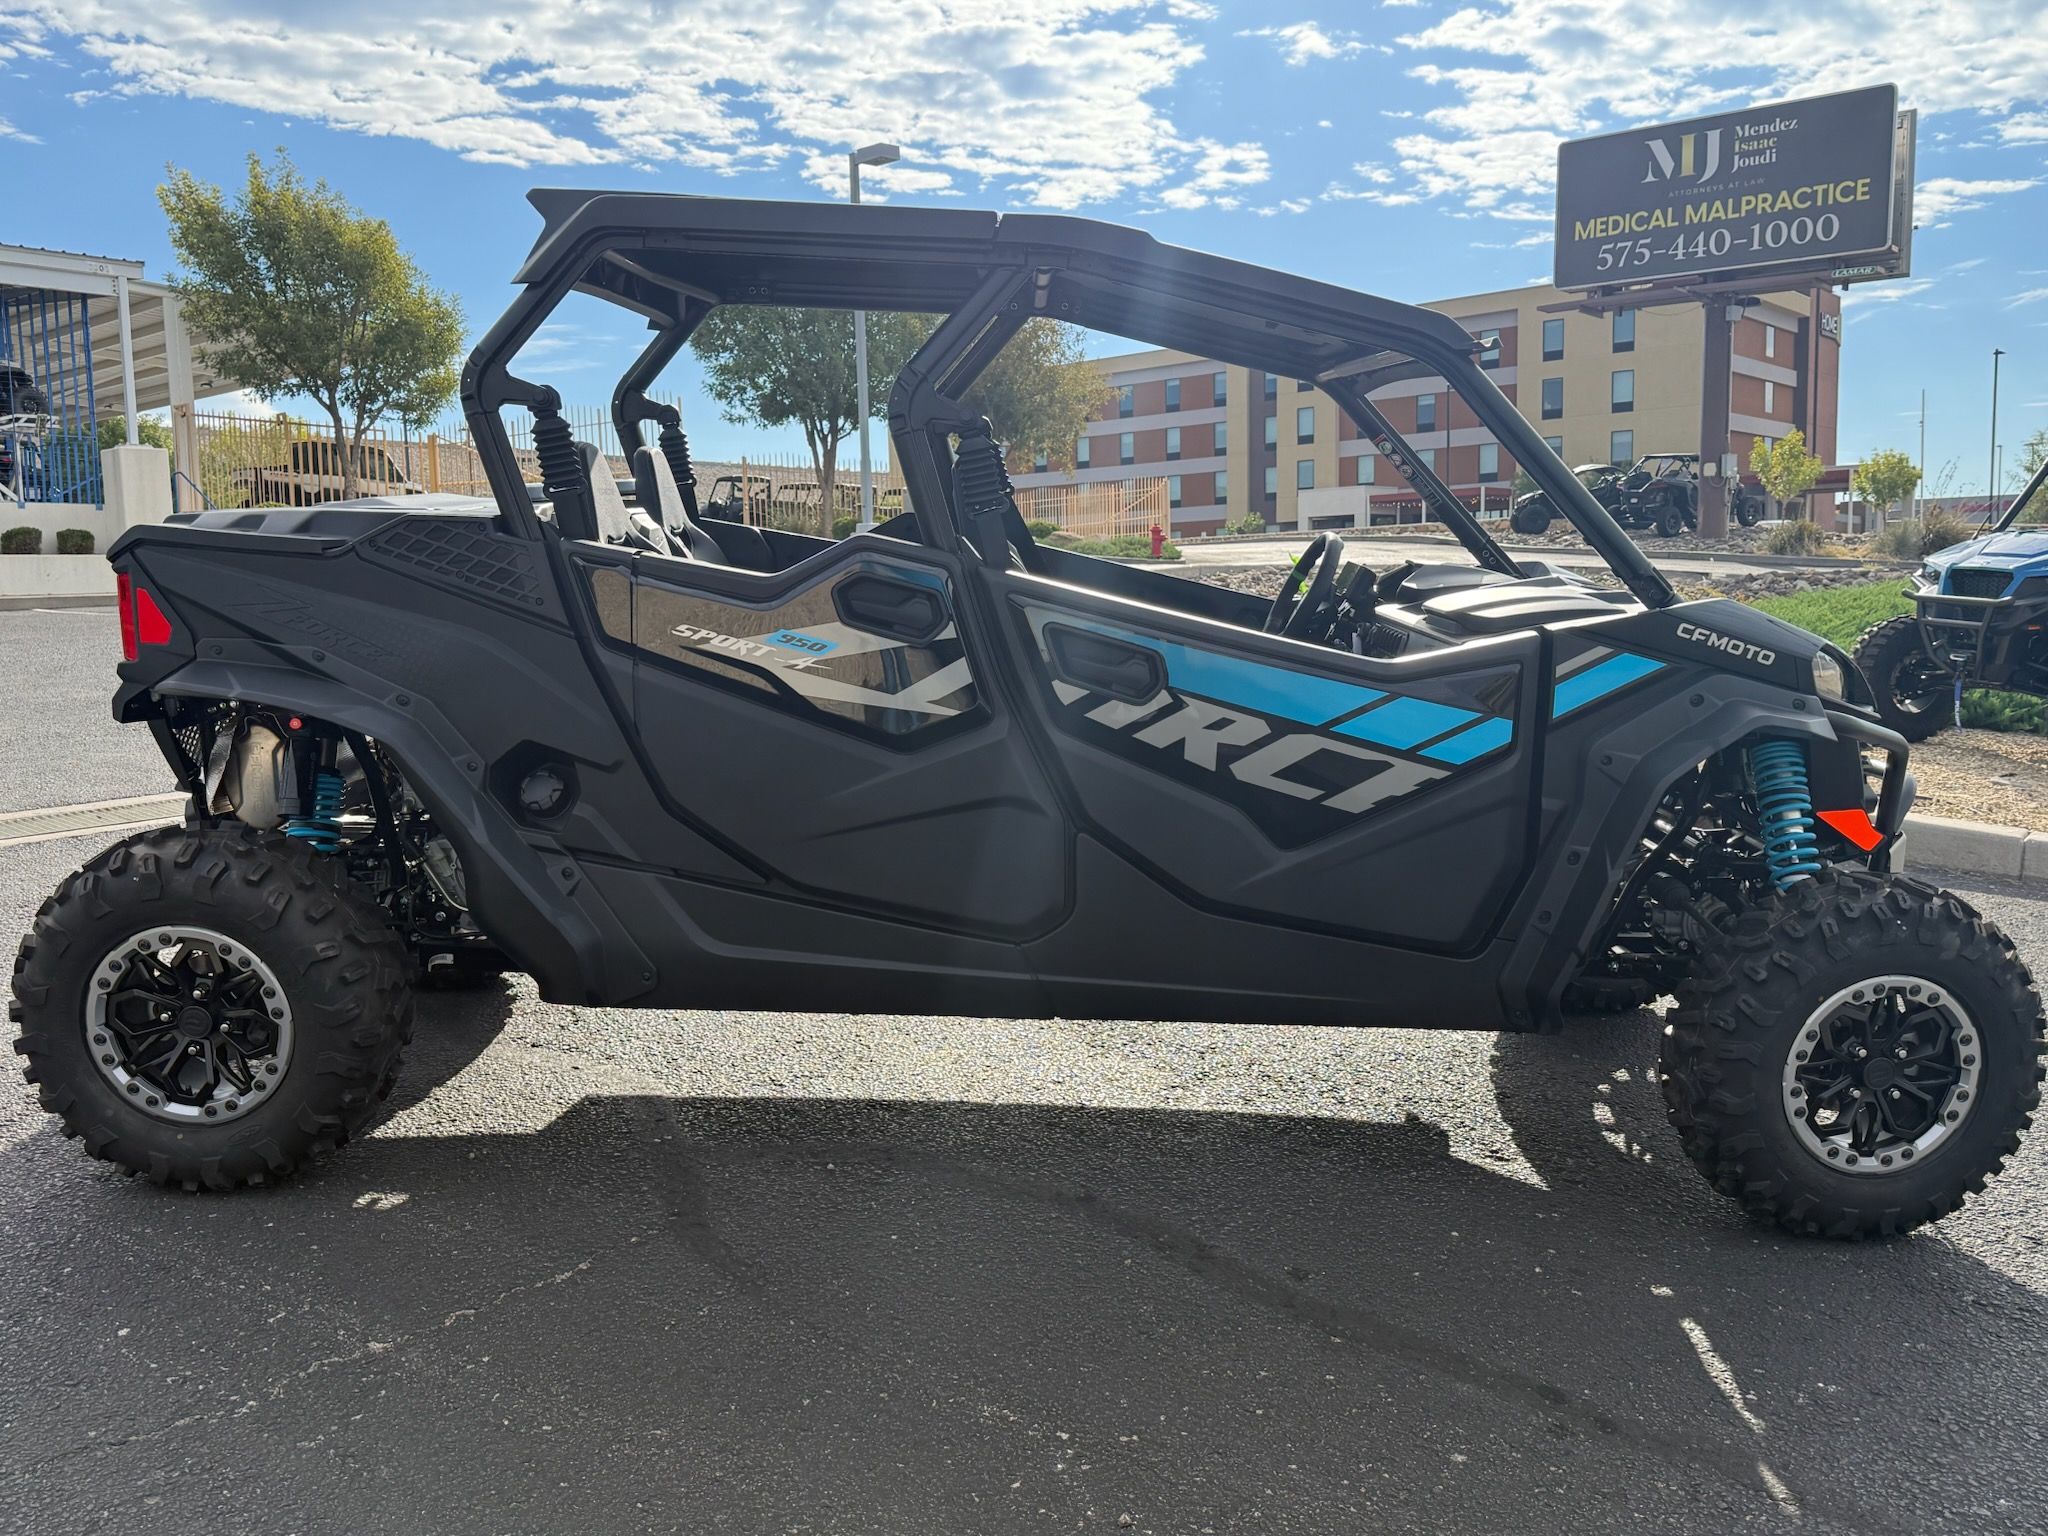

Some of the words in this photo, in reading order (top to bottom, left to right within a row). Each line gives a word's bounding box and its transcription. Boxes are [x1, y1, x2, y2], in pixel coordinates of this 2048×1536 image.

[1734, 118, 1798, 139] Mendez
[1734, 136, 1778, 153] Isaac
[1731, 148, 1777, 174] Joudi
[1668, 183, 1724, 198] ATTORNEYS
[1728, 181, 1740, 190] AT
[1744, 177, 1766, 187] LAW
[1574, 206, 1679, 241] MEDICAL
[1684, 178, 1871, 225] MALPRACTICE
[1596, 213, 1840, 271] 575-440-1000
[1835, 266, 1873, 277] LAMAR
[1821, 311, 1838, 334] HOME
[776, 633, 828, 653] 950
[1676, 622, 1776, 666] CFMOTO
